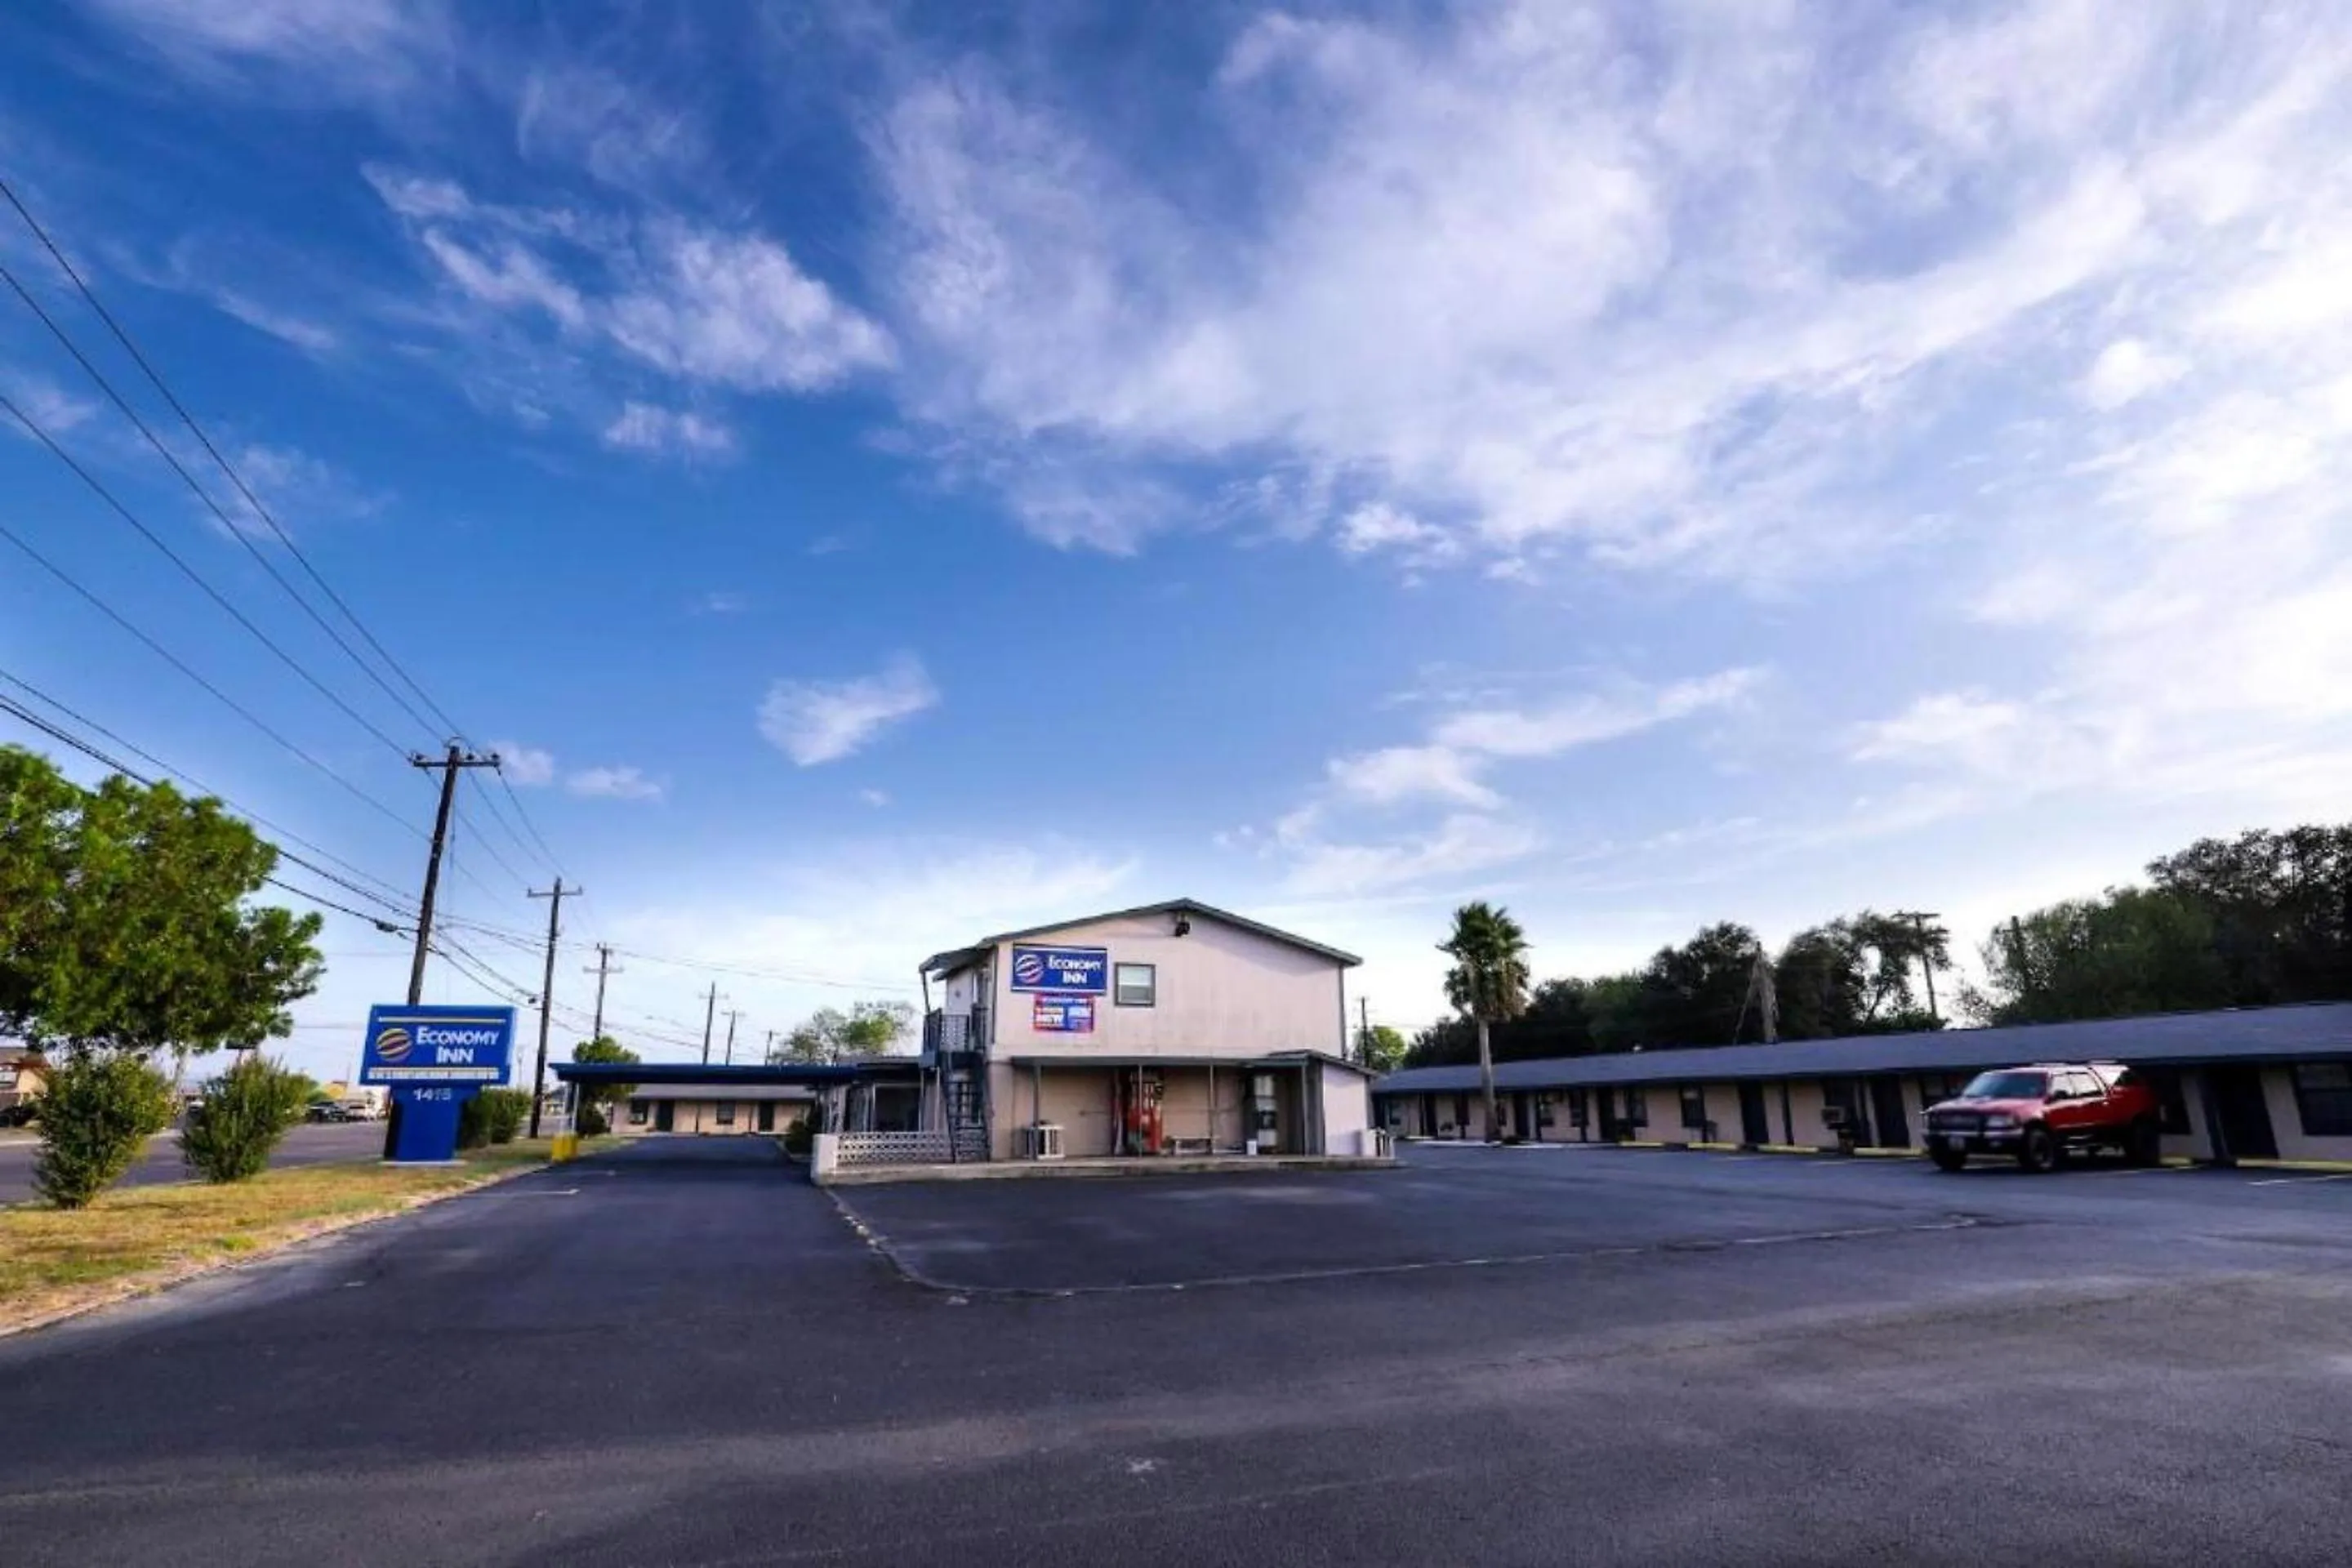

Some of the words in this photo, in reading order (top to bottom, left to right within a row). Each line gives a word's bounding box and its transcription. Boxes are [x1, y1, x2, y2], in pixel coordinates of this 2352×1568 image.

[1049, 955, 1102, 970] ECONOMY
[1062, 970, 1087, 983] INN
[416, 1026, 500, 1045] ECONOMY
[436, 1046, 474, 1064] INN
